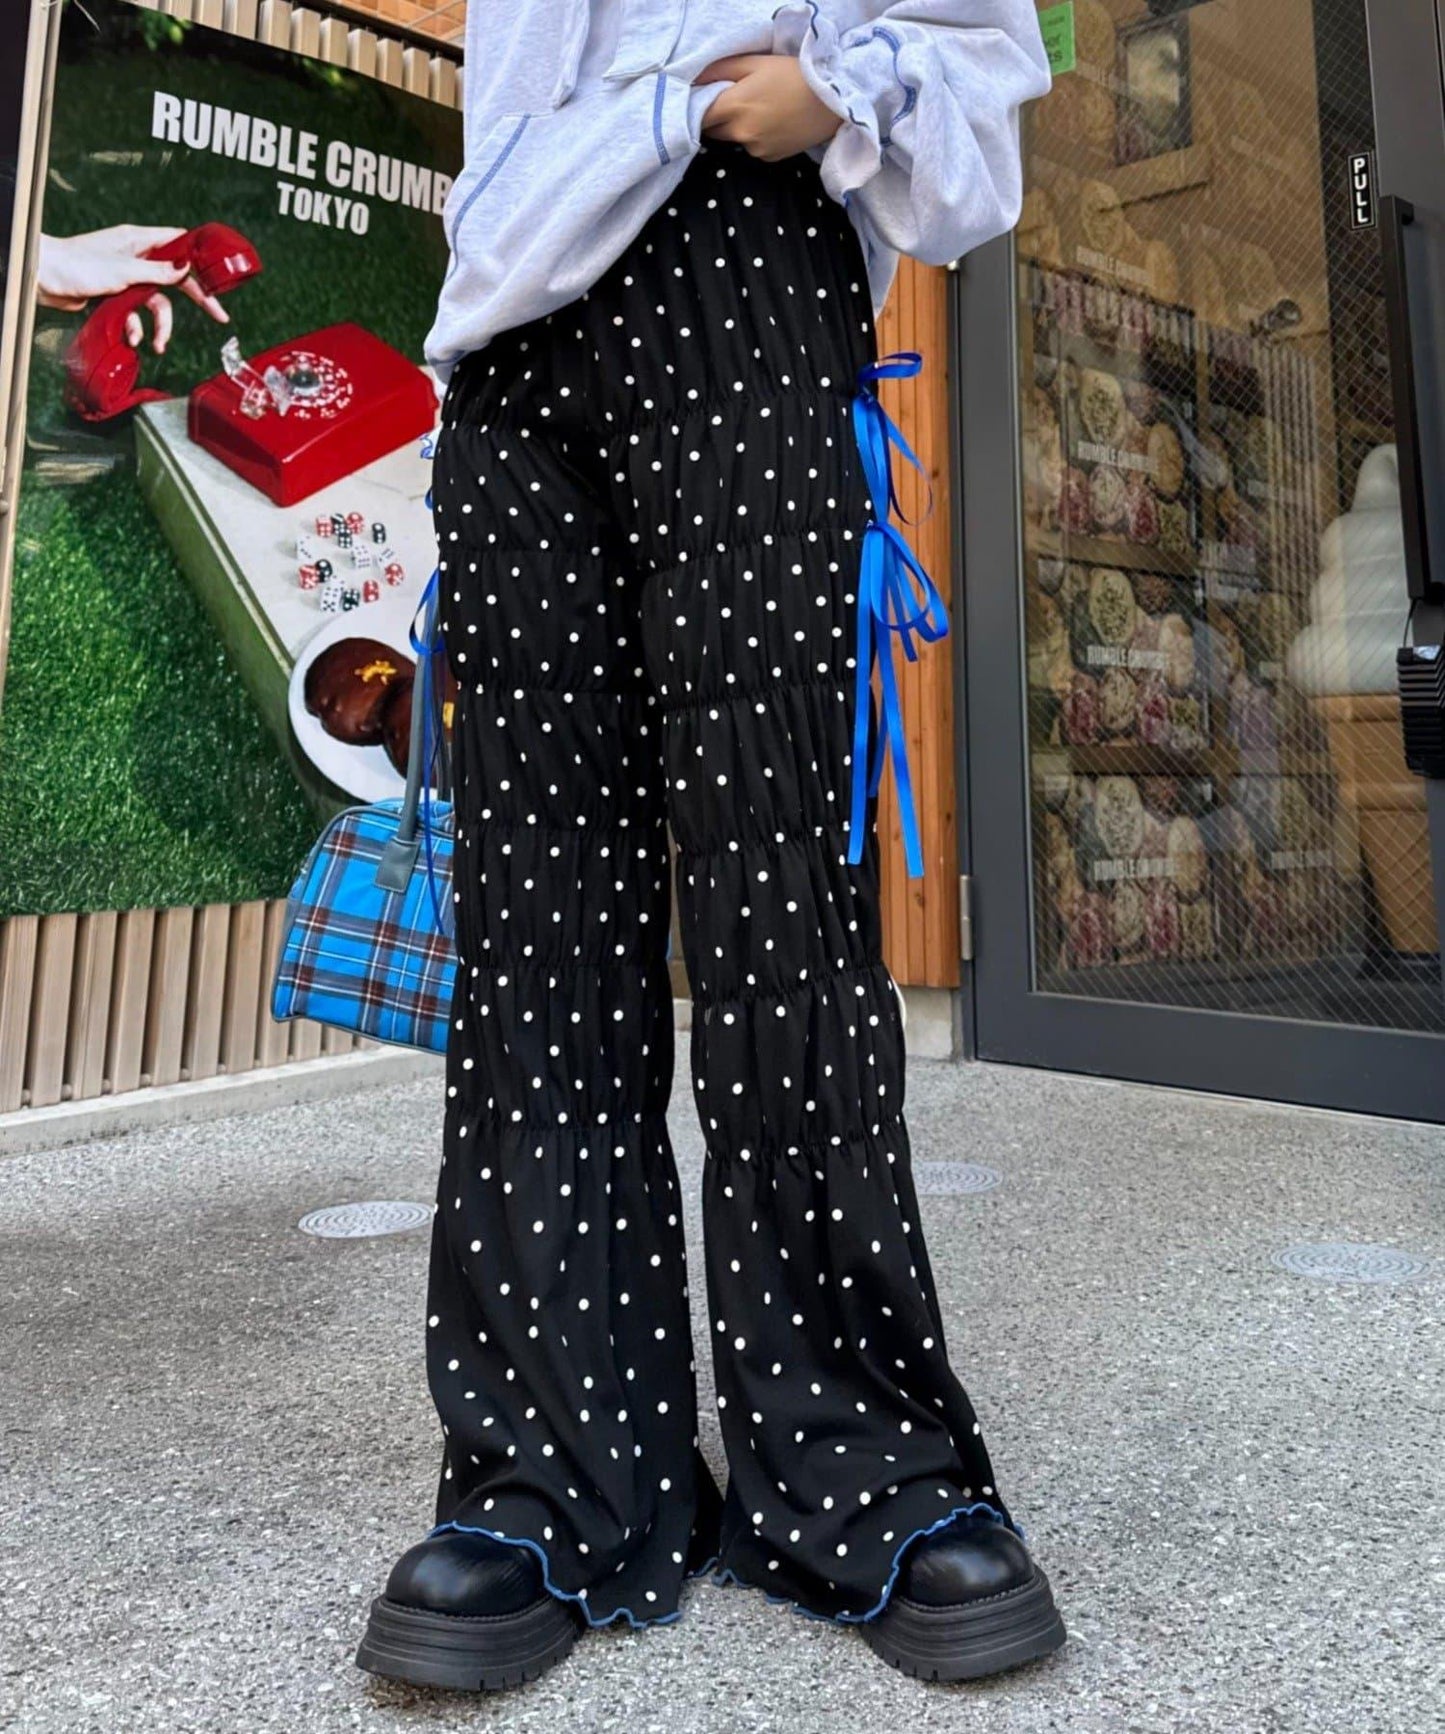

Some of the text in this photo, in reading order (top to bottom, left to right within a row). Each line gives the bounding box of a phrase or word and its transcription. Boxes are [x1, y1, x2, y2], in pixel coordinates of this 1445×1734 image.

[152, 91, 318, 180] RUMBLE
[276, 181, 370, 236] TOKYO
[1353, 157, 1369, 223] PULL
